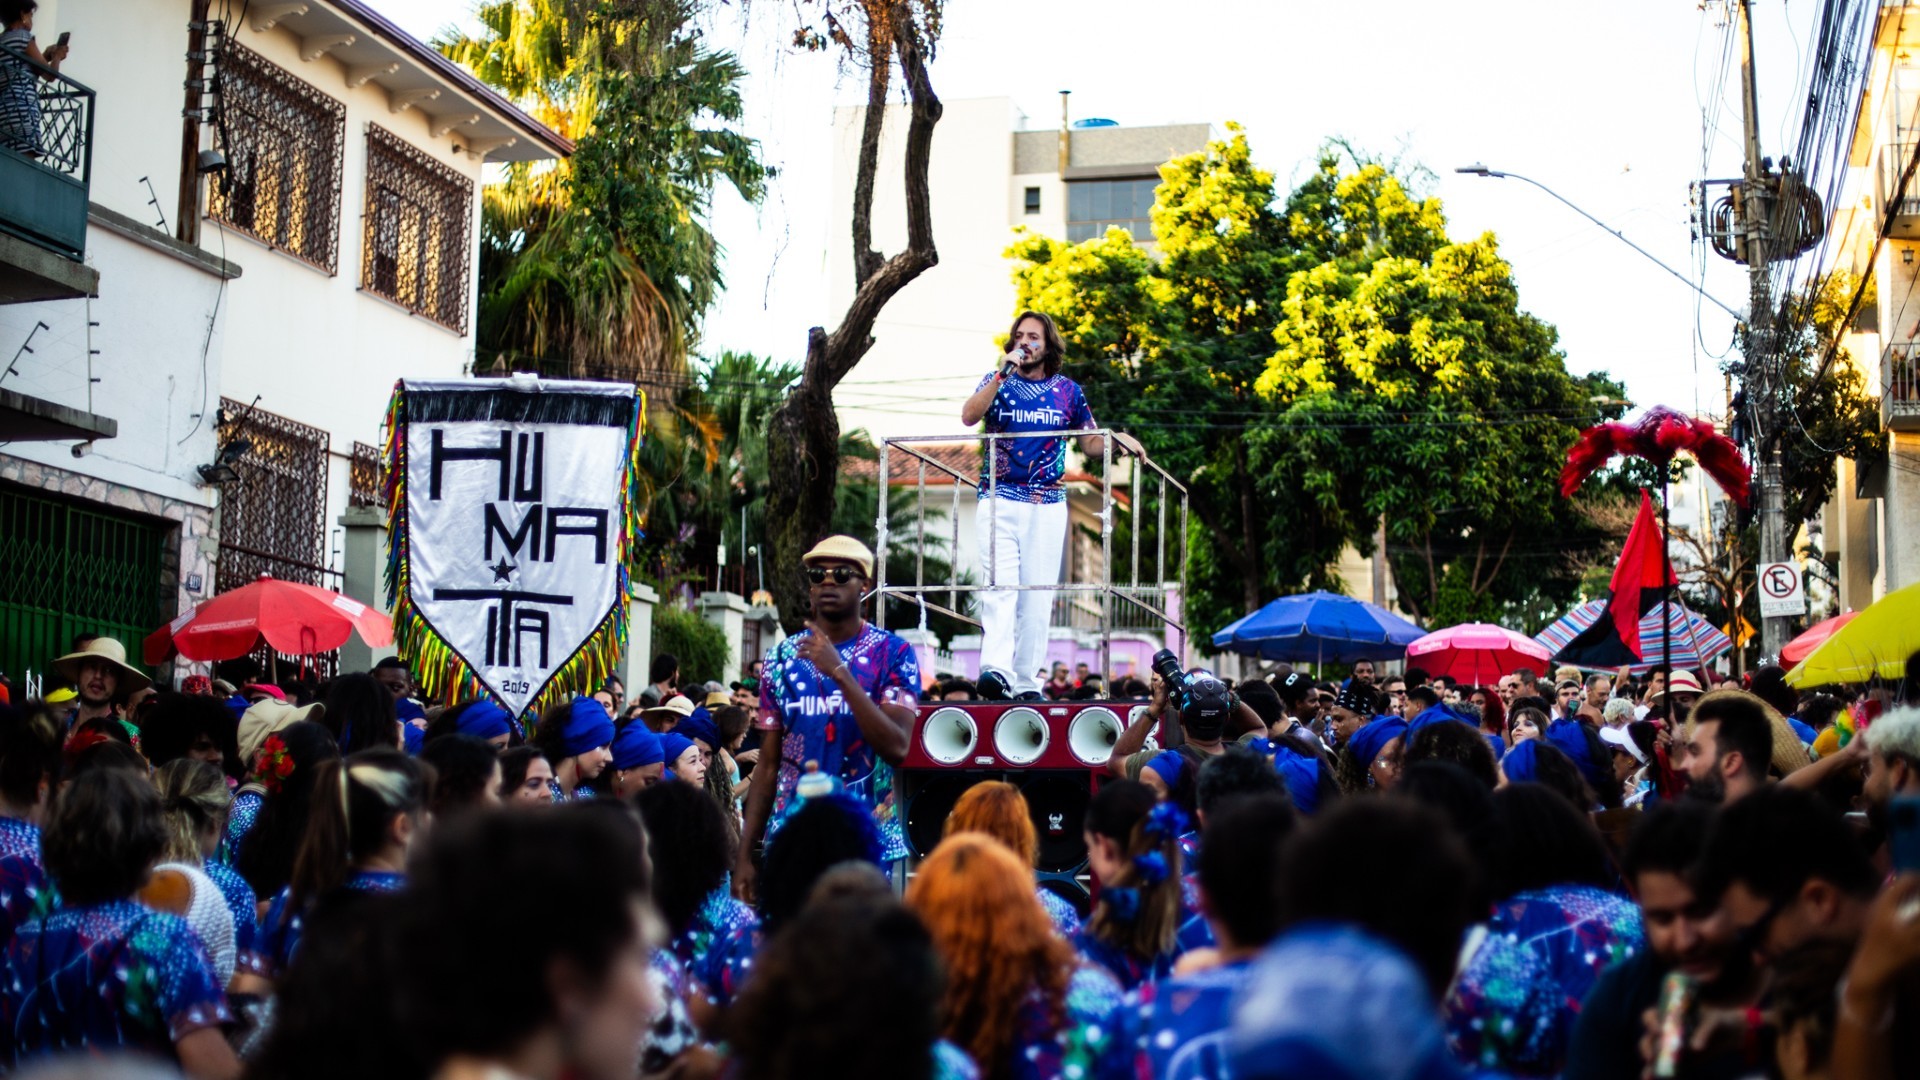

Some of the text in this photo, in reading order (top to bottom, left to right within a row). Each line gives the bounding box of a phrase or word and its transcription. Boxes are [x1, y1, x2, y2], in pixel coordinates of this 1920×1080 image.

[429, 428, 545, 503] HU
[484, 502, 609, 564] MA
[1772, 570, 1789, 593] E
[502, 680, 530, 695] 2019
